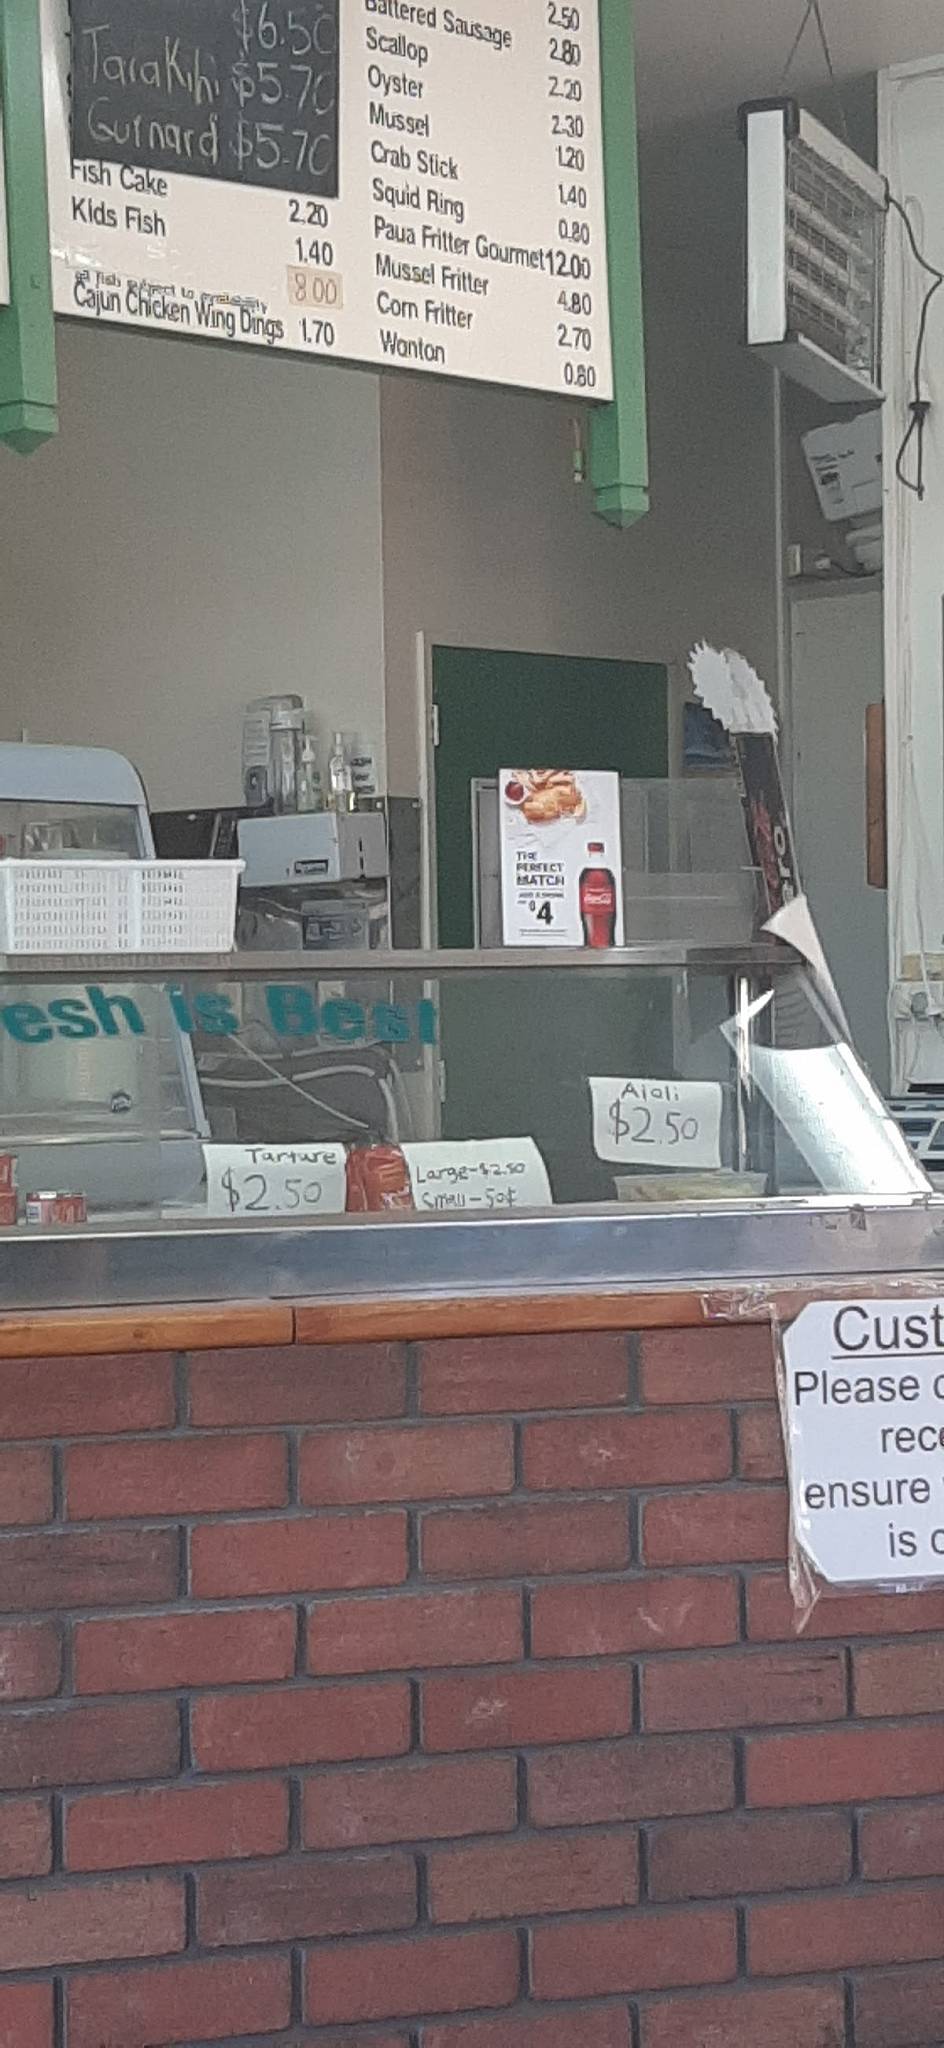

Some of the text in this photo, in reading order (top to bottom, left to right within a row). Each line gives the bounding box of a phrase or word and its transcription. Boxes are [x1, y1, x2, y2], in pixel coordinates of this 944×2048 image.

[443, 10, 512, 50] Sausage
[549, 37, 581, 66] 2.80
[548, 1, 580, 31] 2.50
[366, 27, 582, 101] Scallop 2.20
[87, 96, 220, 165] Gurnard
[368, 65, 584, 137] Oyster 2.30
[369, 101, 584, 171] Mussel 1.20
[70, 159, 328, 228] Fish Cake 2.20
[371, 140, 586, 208] Crab Stick 1.40
[373, 178, 420, 209] Squid
[427, 189, 464, 223] Ring
[72, 196, 333, 267] Kids Fish 1.40
[374, 215, 591, 280] Paua Fritter Gourmet 12.00
[74, 281, 121, 315] Cajun
[126, 288, 190, 324] Chicken
[195, 300, 236, 337] Wing
[240, 304, 284, 344] Dings
[299, 318, 334, 346] 1.70
[376, 253, 591, 315] Mussel Fritter 4.80
[377, 291, 591, 351] Corn Fritter 2.70
[517, 875, 564, 886] MATCH
[2, 981, 437, 1045] esh is Best
[609, 1099, 698, 1144] $2.50
[621, 1082, 679, 1102] Aioli
[221, 1167, 322, 1212] $2.50
[833, 1304, 944, 1351] Cust
[794, 1370, 920, 1406] Please
[805, 1477, 930, 1509] ensure
[888, 1523, 917, 1557] is
